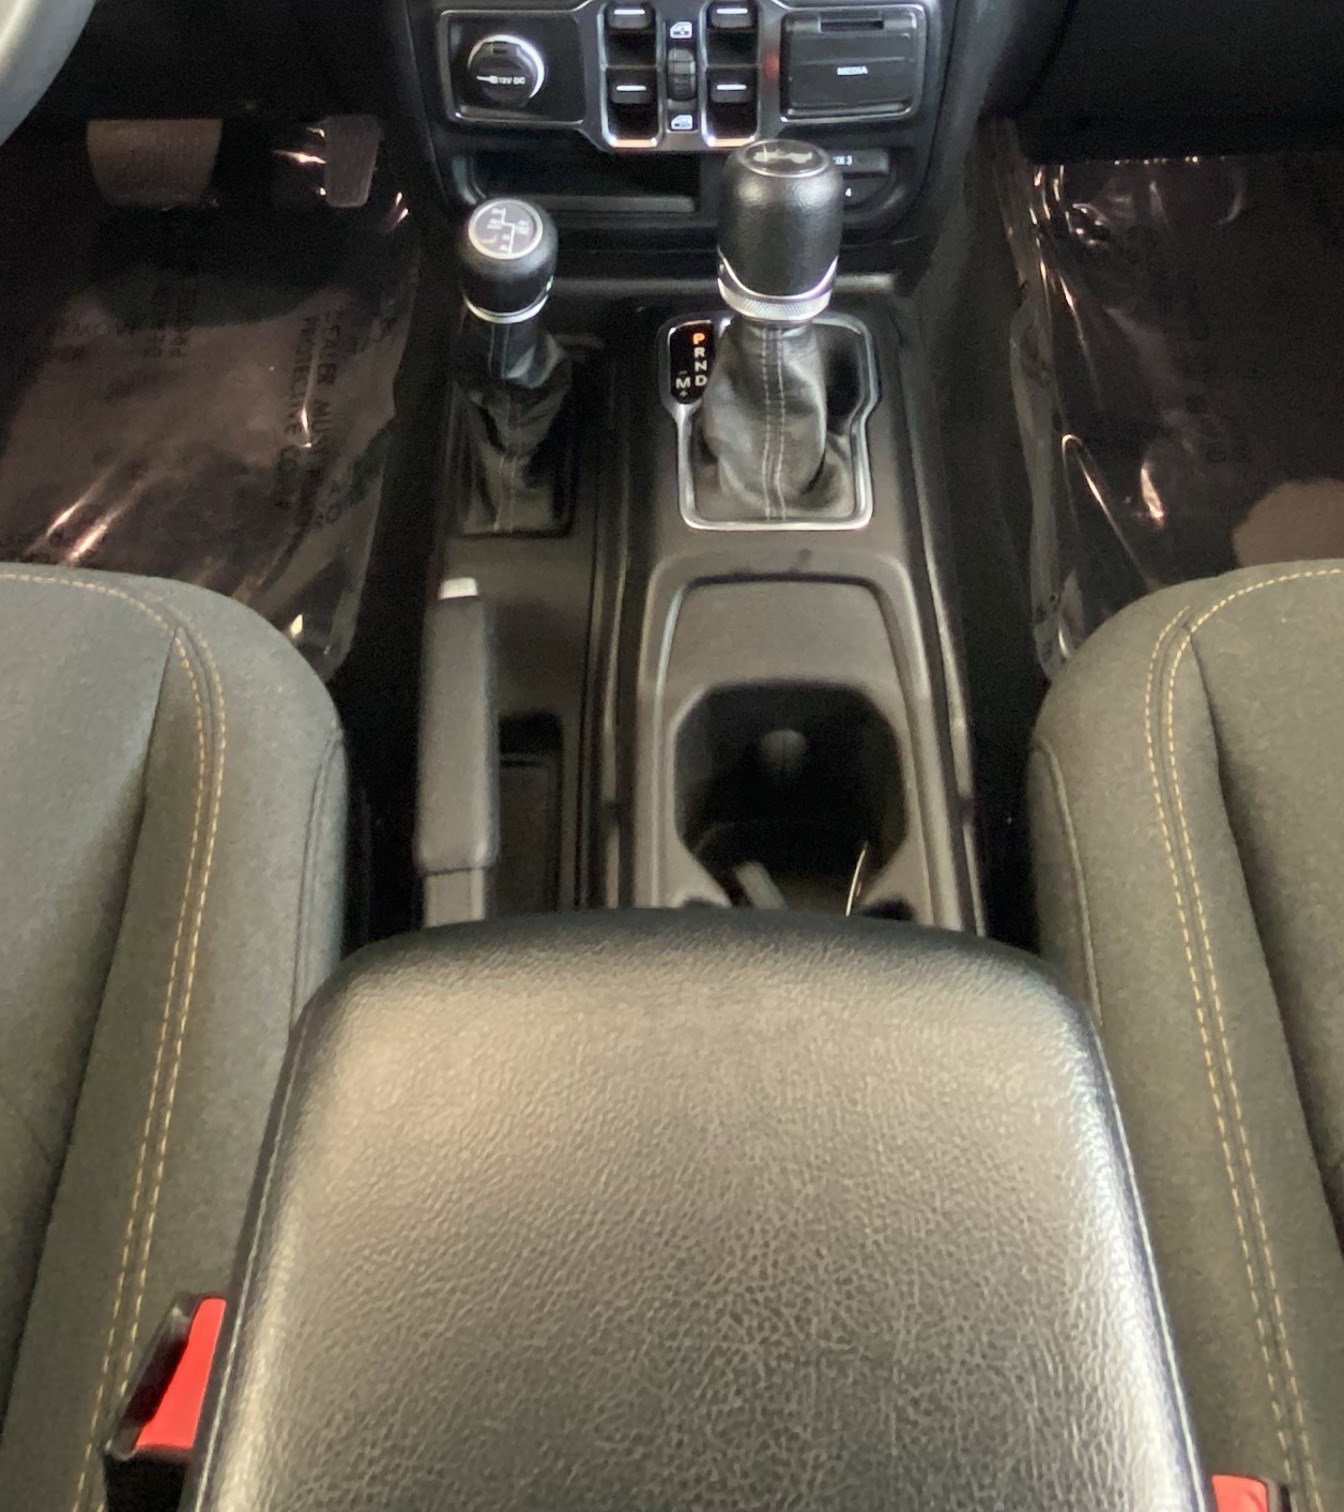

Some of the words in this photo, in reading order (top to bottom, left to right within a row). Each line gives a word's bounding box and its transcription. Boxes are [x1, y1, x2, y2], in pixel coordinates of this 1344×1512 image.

[692, 332, 706, 345] P
[694, 347, 706, 358] R
[694, 360, 708, 372] N
[676, 376, 691, 389] M
[694, 374, 708, 387] D
